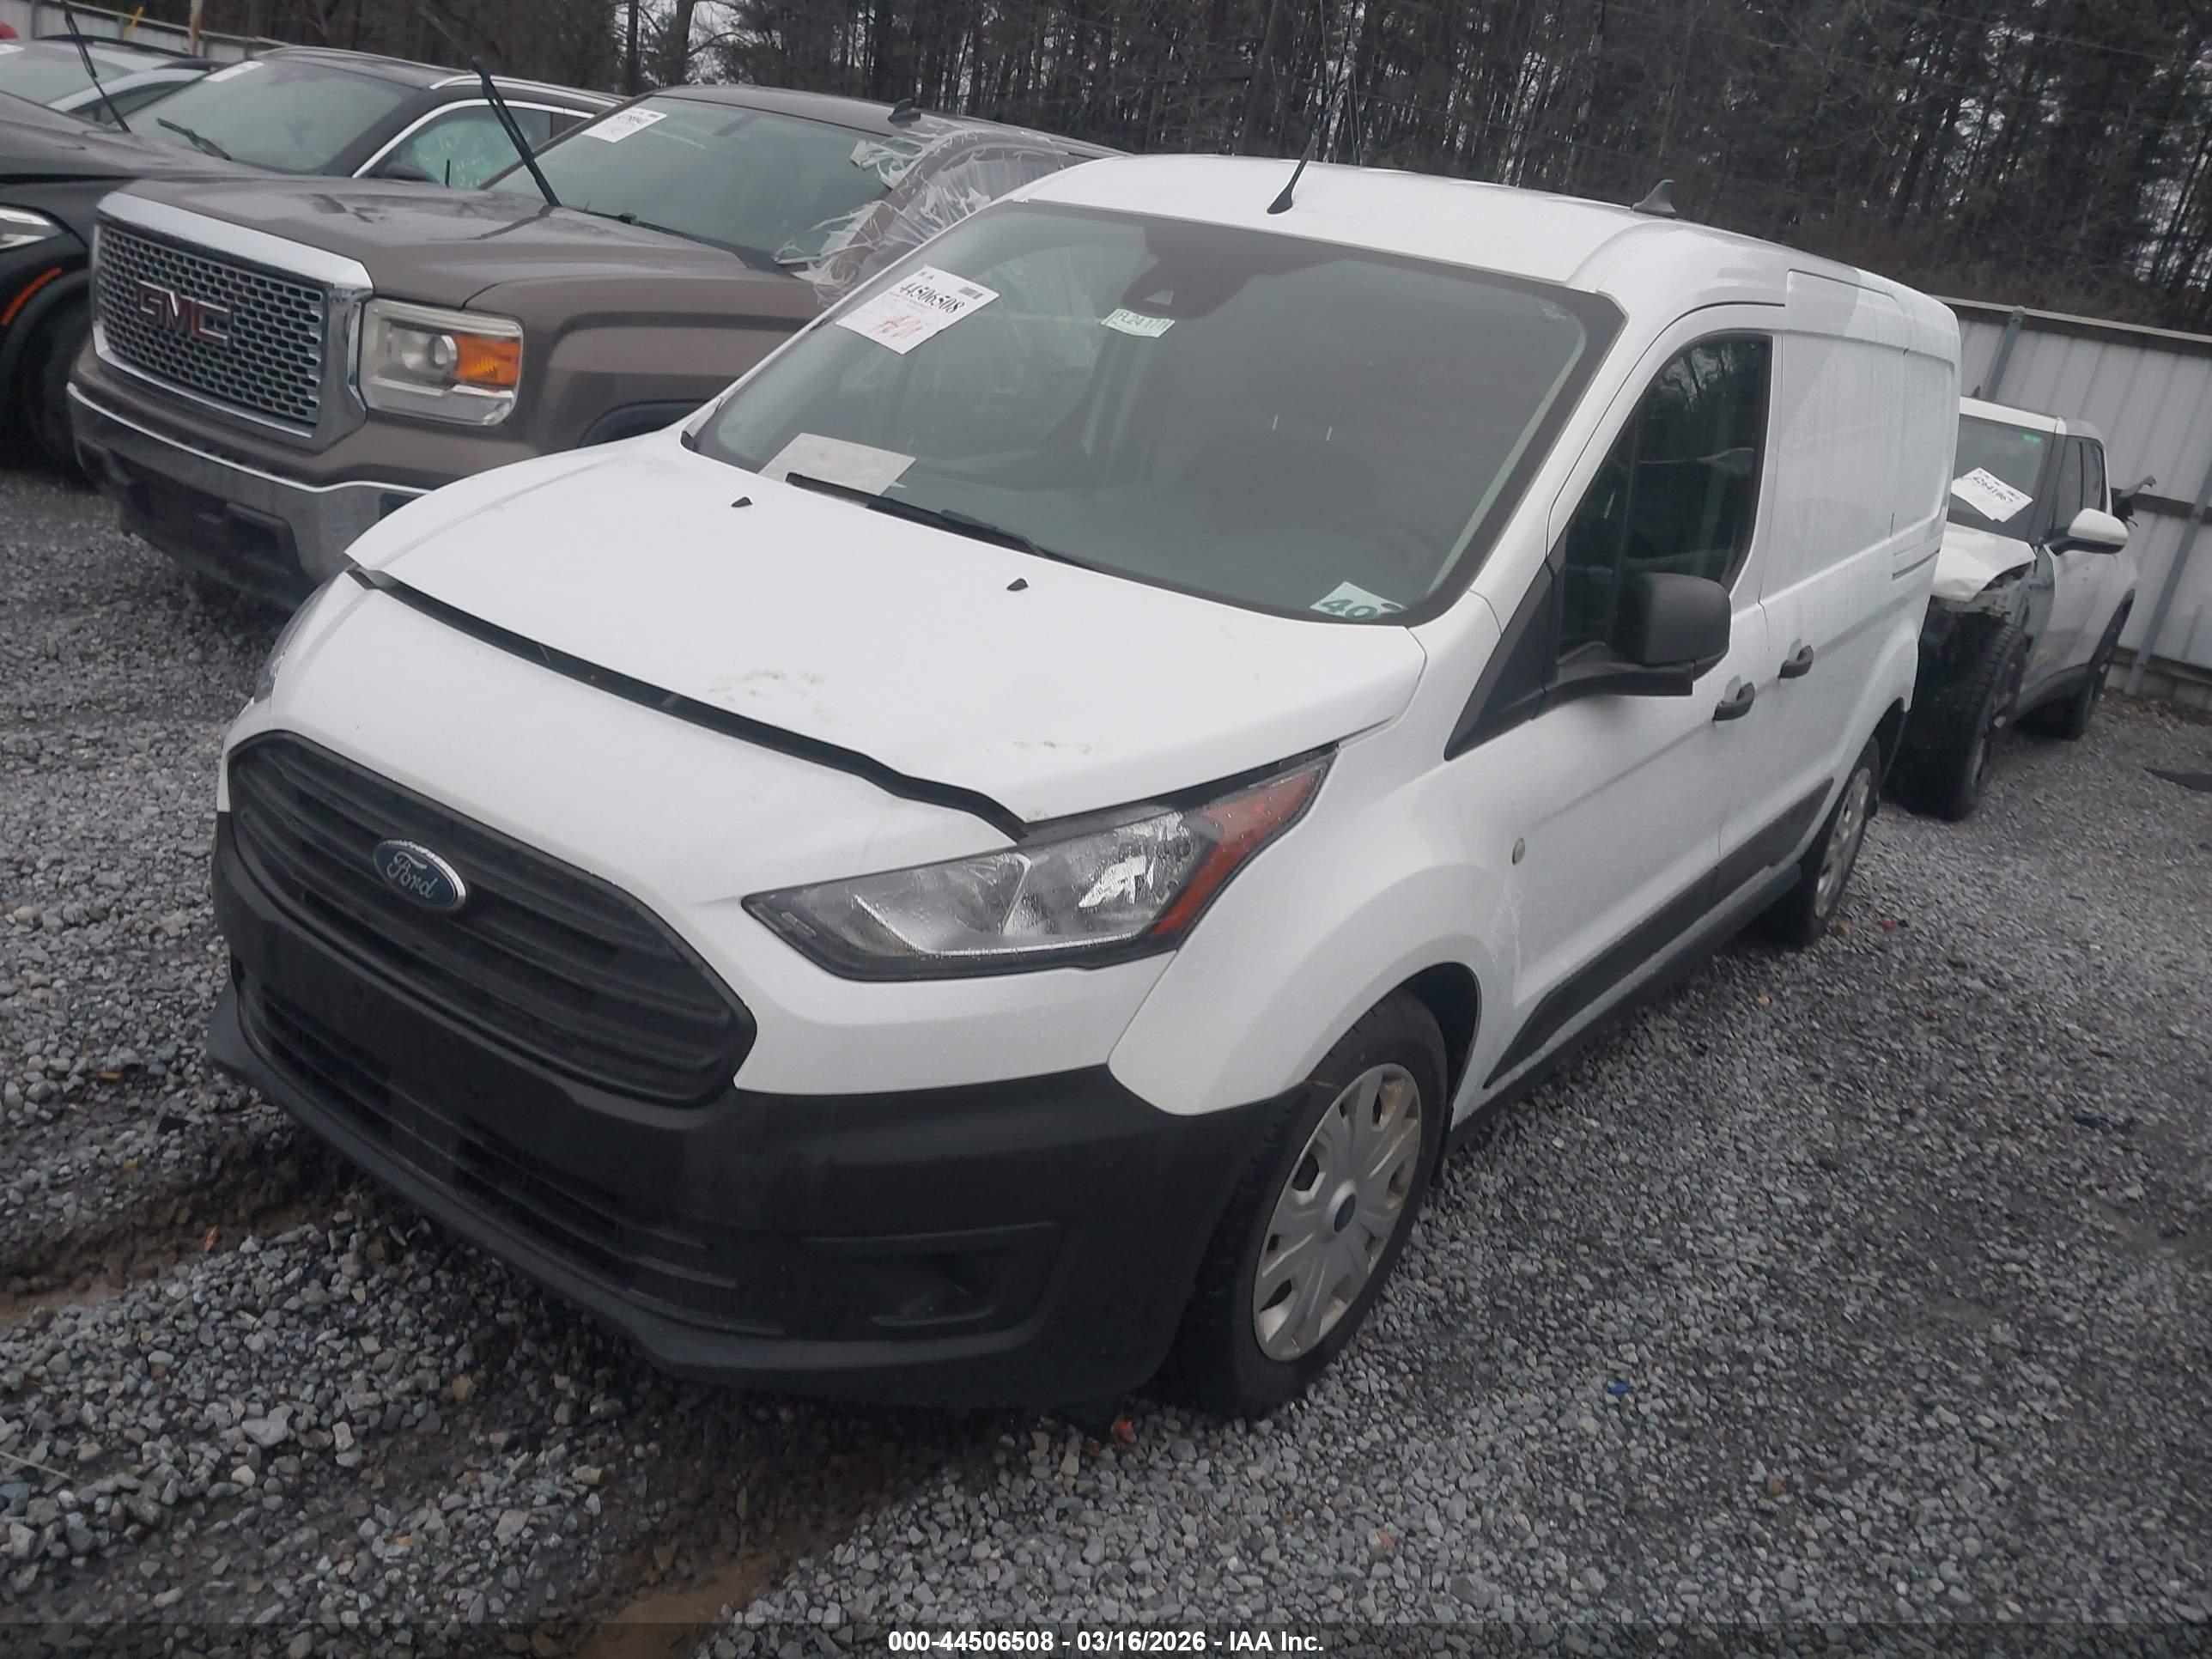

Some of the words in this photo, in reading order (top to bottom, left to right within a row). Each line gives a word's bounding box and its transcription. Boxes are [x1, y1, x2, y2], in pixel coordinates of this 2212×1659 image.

[137, 279, 228, 345] GMC
[900, 283, 965, 313] 44506508
[386, 851, 438, 898] Ford
